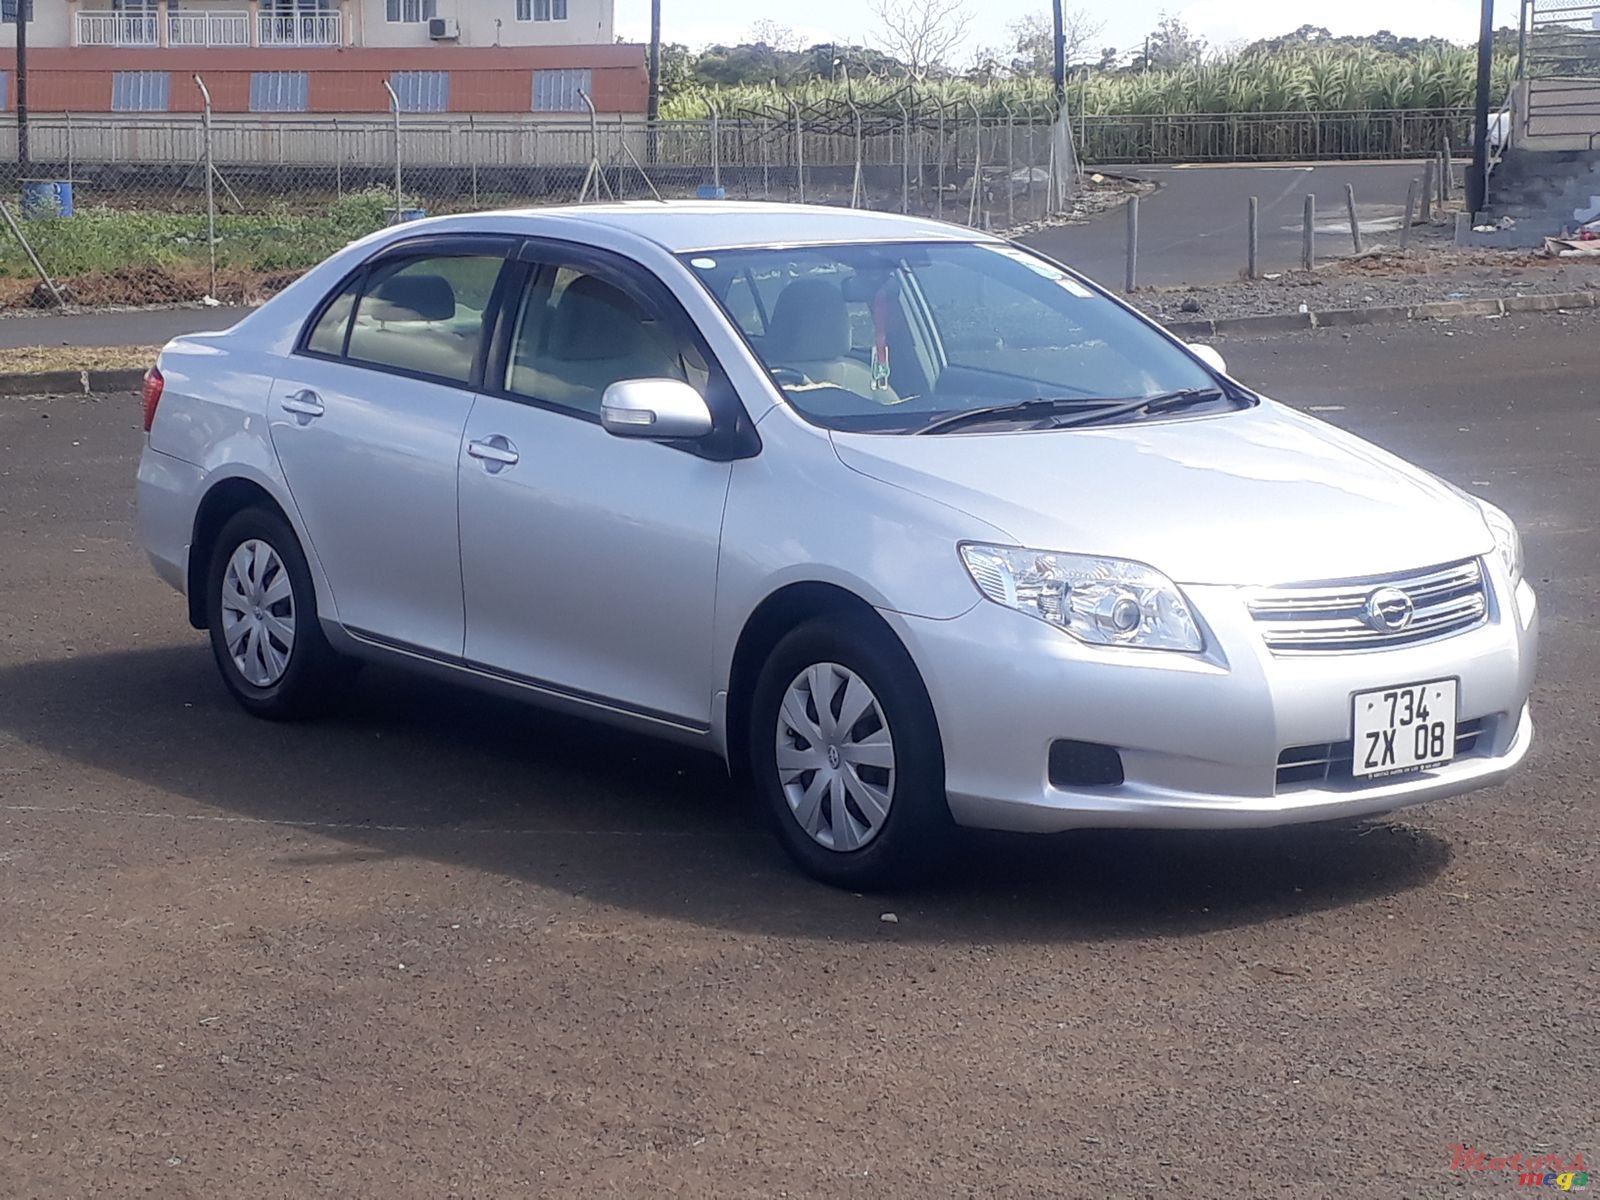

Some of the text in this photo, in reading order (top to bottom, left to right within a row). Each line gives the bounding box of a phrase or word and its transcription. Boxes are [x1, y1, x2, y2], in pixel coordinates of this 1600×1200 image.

[1384, 686, 1429, 728] 734
[1364, 721, 1445, 769] ZX 08
